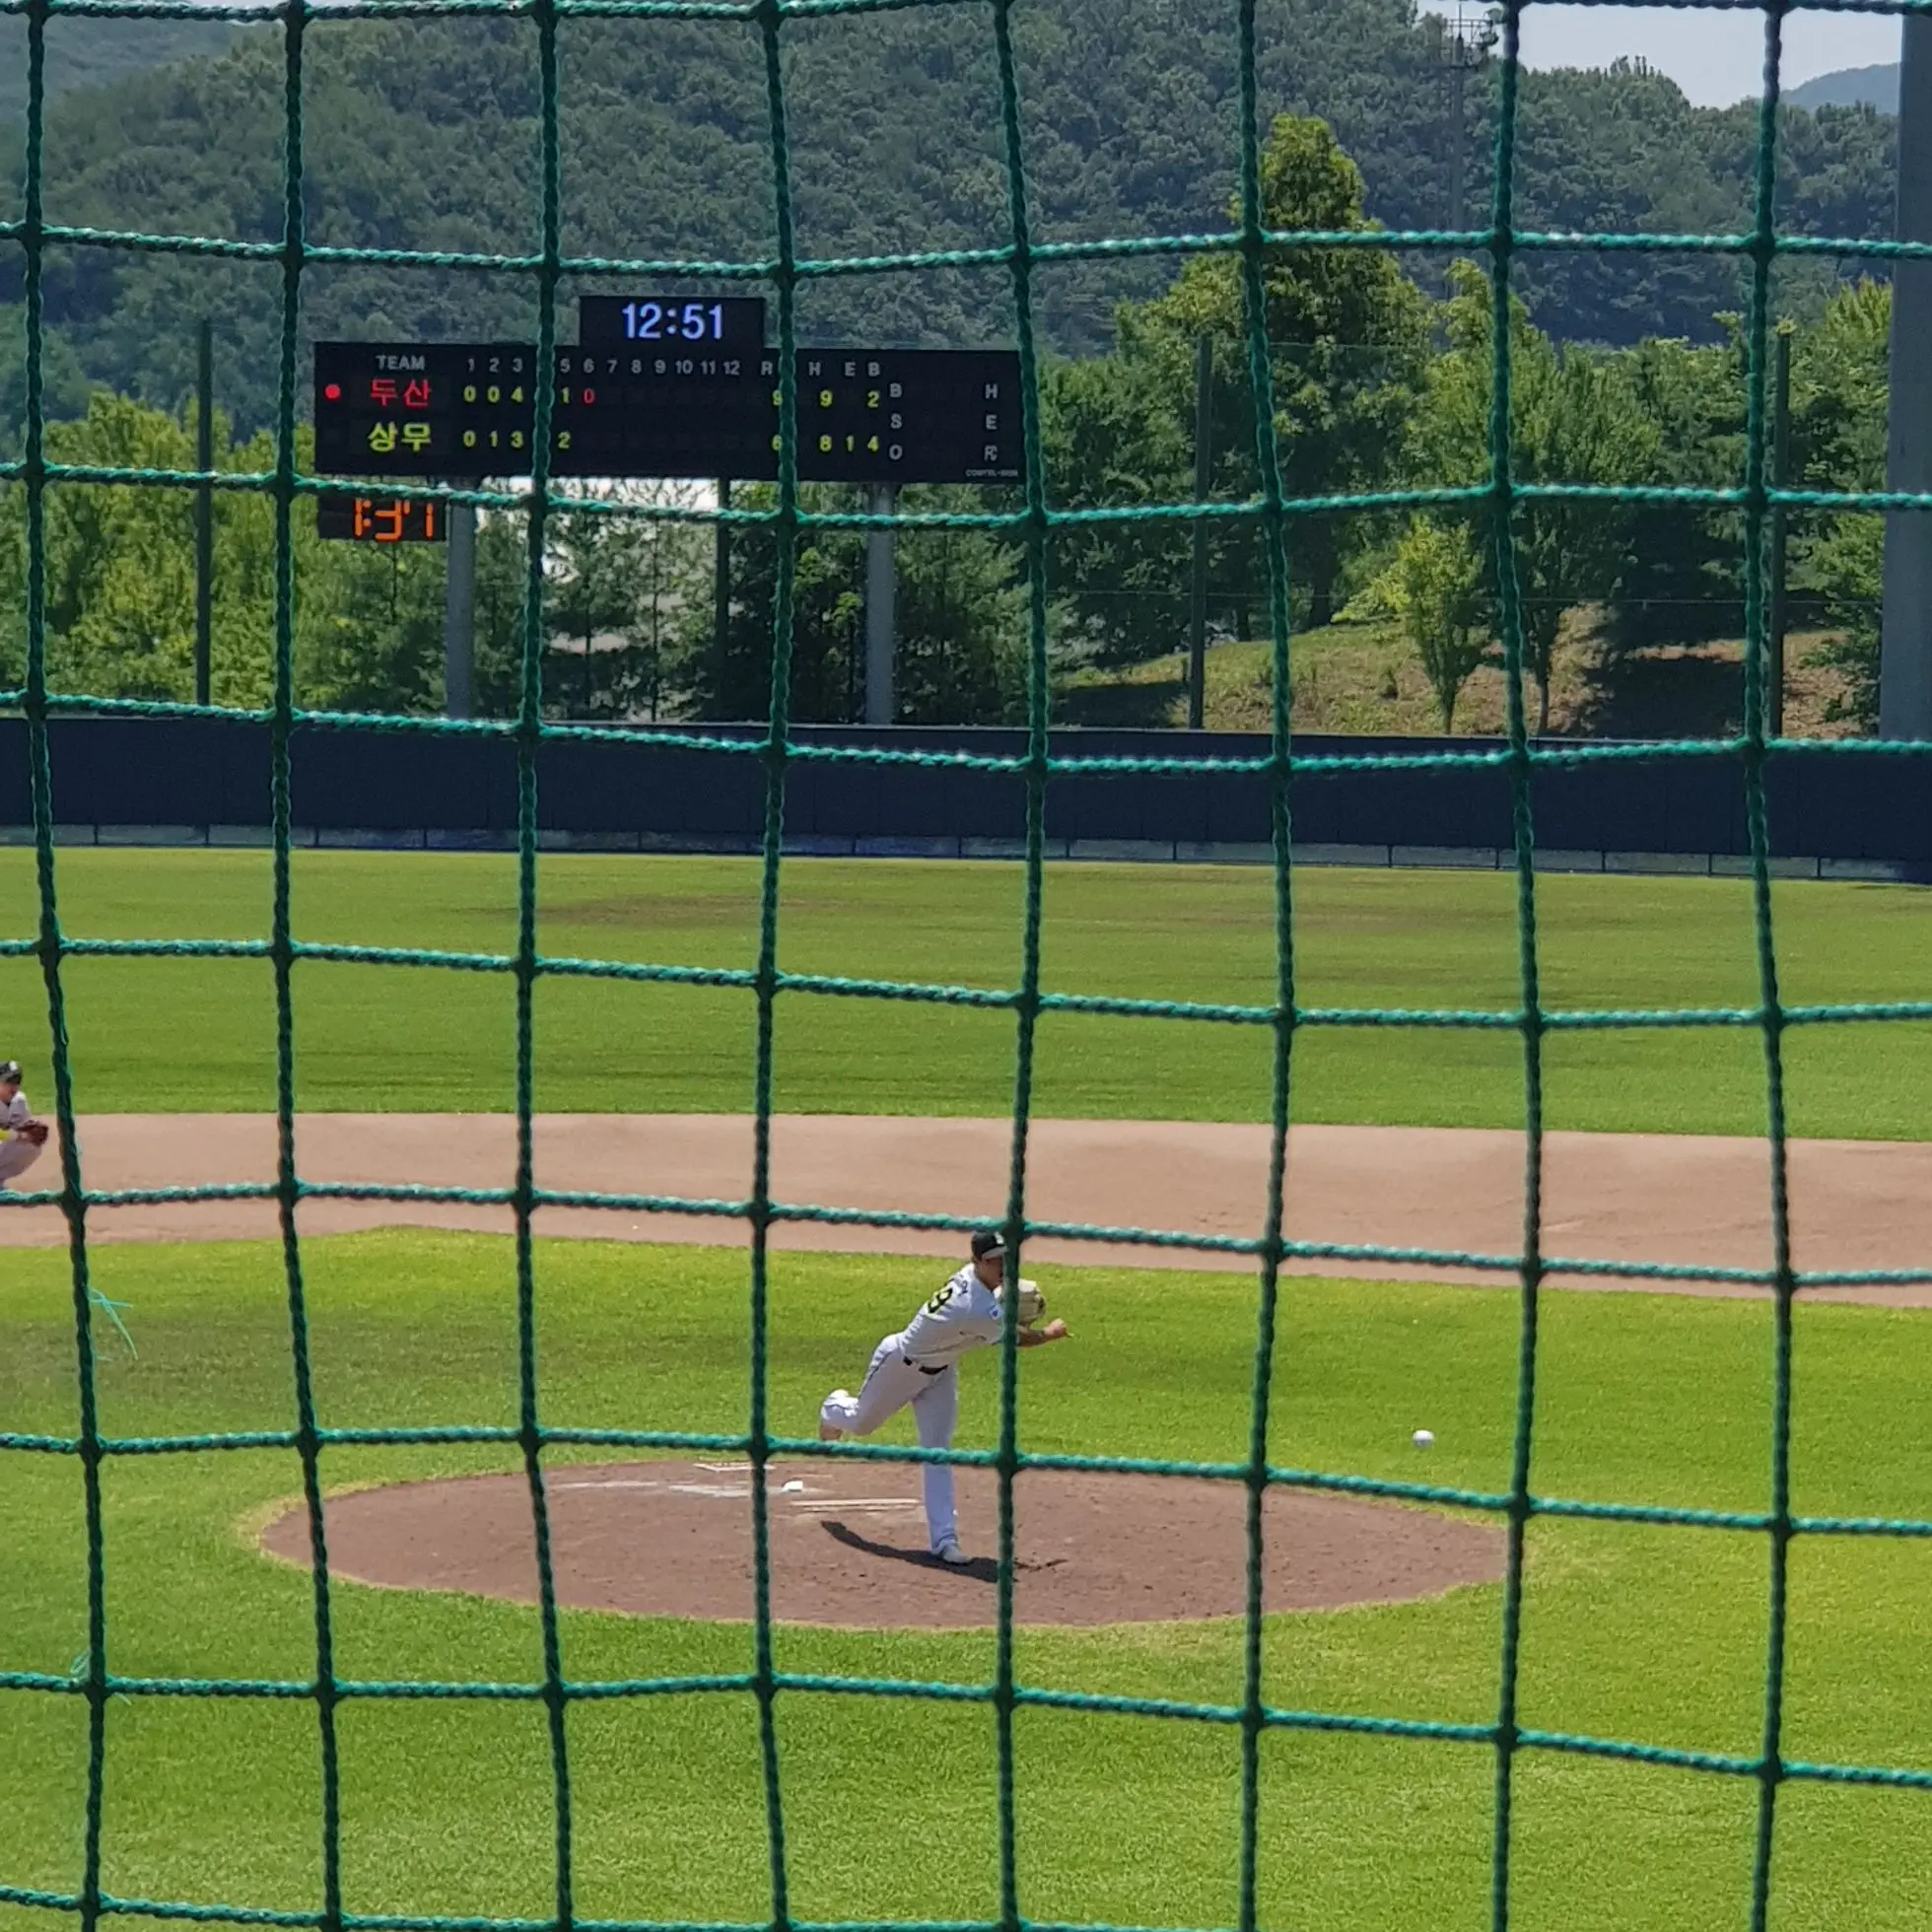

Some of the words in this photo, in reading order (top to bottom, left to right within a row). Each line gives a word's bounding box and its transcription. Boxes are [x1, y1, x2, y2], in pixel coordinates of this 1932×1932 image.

[623, 304, 722, 339] 12:51
[376, 354, 426, 371] TEAM
[467, 358, 475, 372] 1
[489, 357, 500, 373] 2
[512, 357, 523, 373] 3
[560, 358, 571, 374] 5
[583, 358, 595, 374] 6
[606, 359, 618, 374] 7
[631, 359, 643, 375] 8
[654, 359, 666, 375] 9
[675, 359, 694, 375] 10
[701, 360, 716, 376] 11
[723, 359, 740, 376] 12
[760, 360, 774, 376] R
[808, 361, 822, 377] H
[844, 361, 857, 377] E
[867, 361, 880, 377] B
[370, 379, 432, 407] 두산
[463, 384, 477, 402] 0
[487, 385, 501, 403] 0
[511, 385, 523, 403] 4
[561, 386, 570, 403] 1
[583, 388, 595, 404] 0
[819, 389, 833, 407] 9
[867, 390, 880, 408] 2
[889, 382, 903, 398] B
[985, 383, 999, 399] H
[890, 413, 903, 430] S
[985, 414, 998, 430] E
[368, 421, 432, 452] 상무
[462, 430, 476, 448] 0
[490, 430, 498, 448] 1
[511, 430, 524, 448] 3
[558, 431, 571, 449] 2
[819, 434, 832, 451] 8
[846, 435, 855, 451] 1
[866, 436, 879, 451] 4
